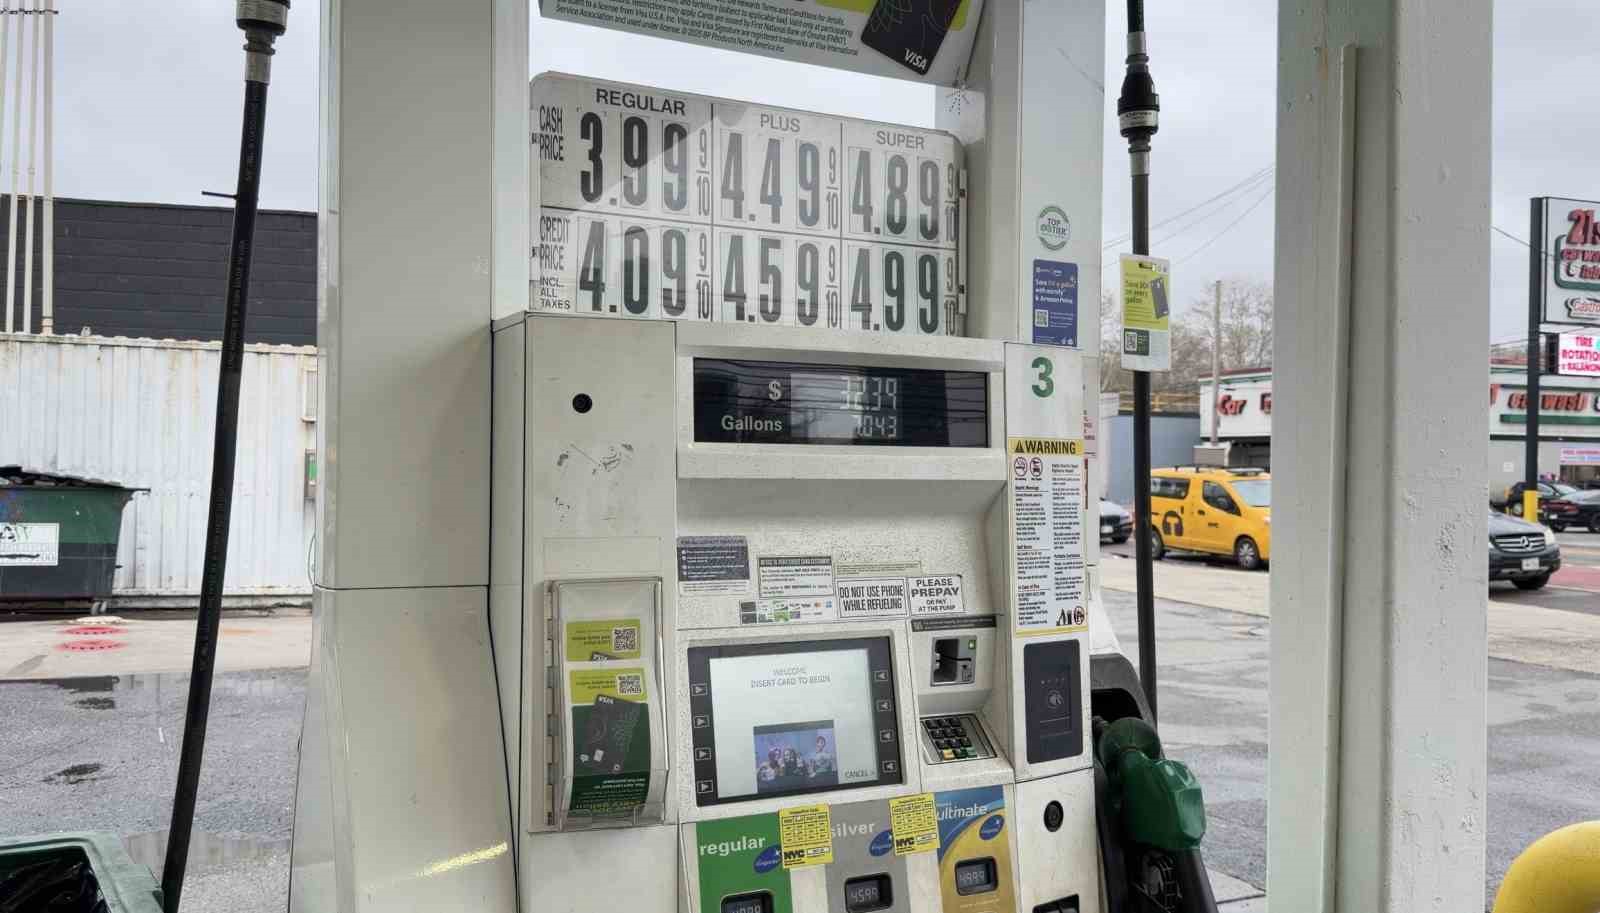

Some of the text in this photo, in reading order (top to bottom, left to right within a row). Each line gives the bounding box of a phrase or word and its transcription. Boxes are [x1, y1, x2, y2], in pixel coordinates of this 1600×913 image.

[789, 8, 816, 19] Conditions
[556, 4, 578, 18] Service
[580, 8, 613, 24] Association
[614, 15, 626, 26] and
[626, 17, 640, 28] used
[712, 33, 736, 44] Products
[736, 37, 752, 47] North
[754, 40, 774, 51] America
[904, 48, 928, 70] VISA
[596, 88, 686, 116] REGULAR
[540, 105, 562, 133] CASH
[760, 113, 800, 132] PLUS
[540, 134, 564, 162] PRICE
[877, 130, 926, 150] SUPER
[580, 112, 689, 211] 3.99
[720, 132, 820, 228] 4.49
[850, 150, 940, 241] 4.89
[540, 216, 570, 243] CREDIT
[540, 244, 564, 270] PRICE
[580, 220, 688, 318] 4.09
[724, 234, 819, 326] 4.59
[540, 288, 558, 298] ALL
[851, 248, 940, 334] 4.99
[540, 298, 570, 310] TAXES
[1576, 336, 1592, 347] TIRE
[1562, 350, 1600, 361] ROTATIO
[1032, 356, 1054, 398] 3
[768, 380, 781, 401] $
[1216, 394, 1247, 416] Car
[722, 414, 782, 431] Gallons
[1025, 440, 1076, 454] WARNING
[840, 585, 904, 598] DO NOT USE PHONE
[912, 587, 958, 597] PREPAY
[917, 578, 952, 587] PLEASE
[844, 599, 865, 611] WHILE
[867, 598, 902, 610] REFUELING
[773, 667, 807, 676] WELCOME
[751, 675, 831, 688] INSERT CARD TO BEGIN
[845, 770, 869, 779] CANCEL
[936, 804, 988, 820] ultimate
[831, 822, 875, 838] silver
[700, 836, 766, 857] regular
[896, 837, 914, 848] NYC
[784, 850, 805, 860] NYC
